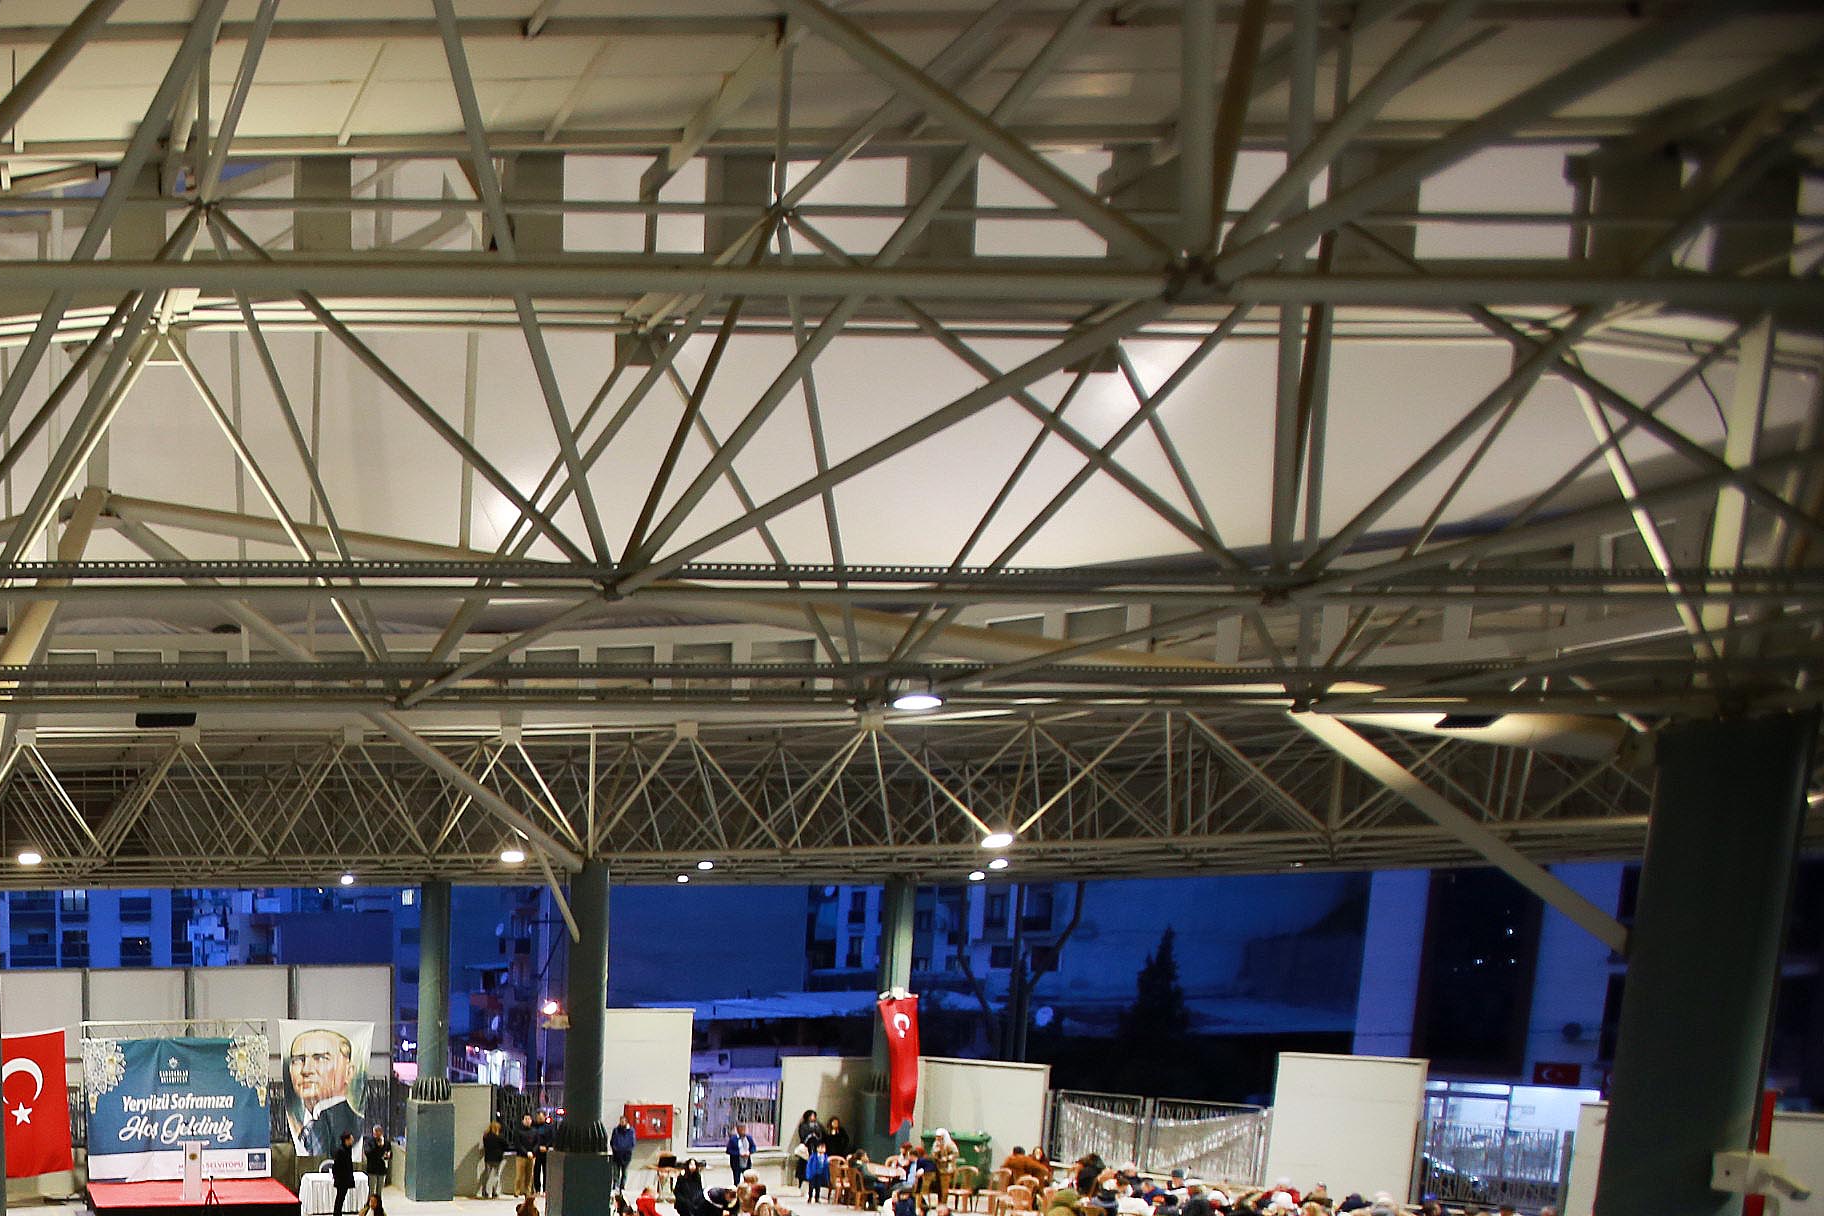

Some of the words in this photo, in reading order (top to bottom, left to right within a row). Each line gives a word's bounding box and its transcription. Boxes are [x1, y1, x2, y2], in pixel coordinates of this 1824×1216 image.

[122, 1094, 169, 1115] Yeryüzü
[170, 1093, 234, 1110] Soframıza
[119, 1116, 158, 1141] Hoş
[160, 1113, 234, 1144] Geldiniz
